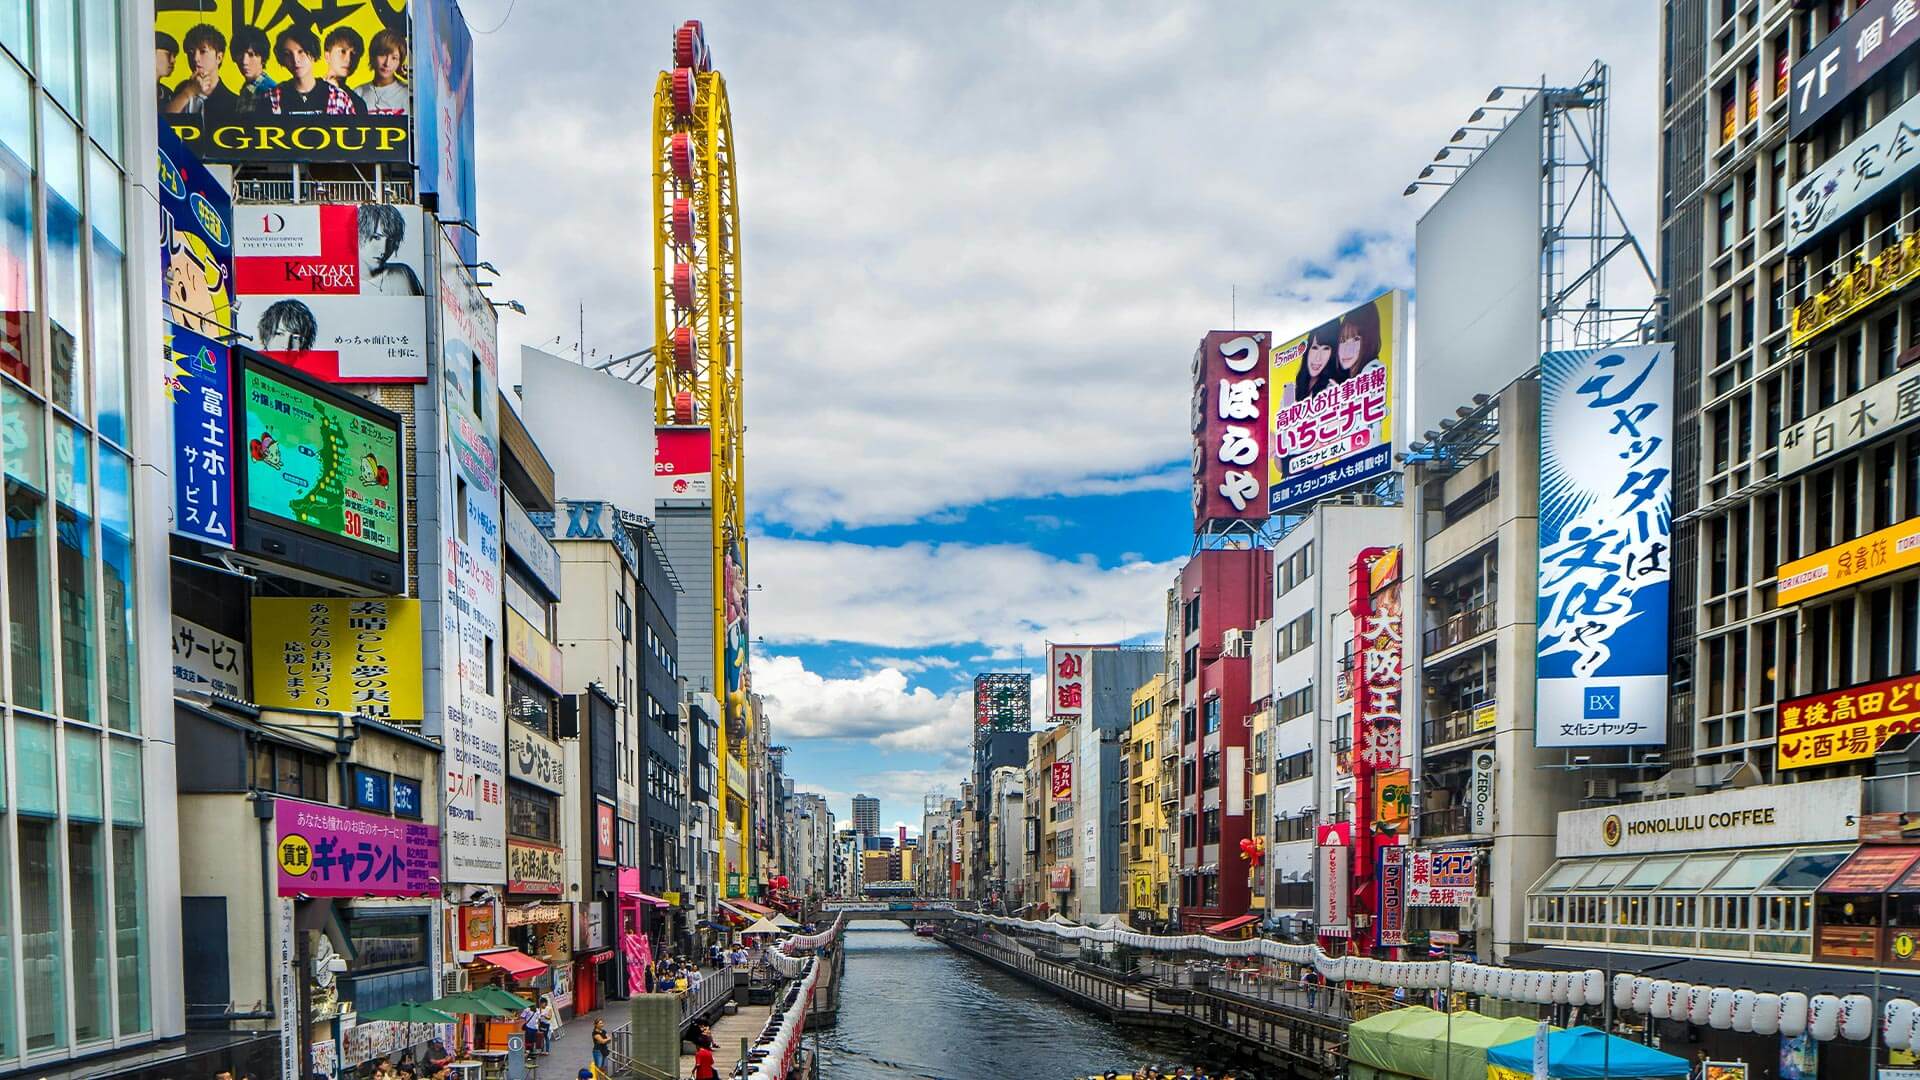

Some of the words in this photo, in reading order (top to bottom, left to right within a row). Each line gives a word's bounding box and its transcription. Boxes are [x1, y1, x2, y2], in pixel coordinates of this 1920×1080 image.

[1796, 46, 1841, 115] 7F
[212, 126, 407, 151] GROUP
[285, 262, 354, 281] KANZAKI
[311, 275, 355, 291] RUKA
[334, 335, 409, 346] めっちゃ面白いを
[387, 349, 420, 359] 仕事に。
[1276, 367, 1386, 429] 高収入お仕事情報
[1219, 333, 1265, 511] づぼらや
[1276, 397, 1386, 454] いちごナビ
[1783, 425, 1805, 450] 4F
[1812, 376, 1920, 461] 白木屋
[200, 386, 227, 538] 富士ホーム
[1292, 449, 1328, 470] いちごナビ
[1330, 443, 1347, 456] 求人
[184, 445, 201, 524] サービス
[345, 511, 361, 538] 30
[284, 641, 305, 699] 応援します
[310, 603, 332, 707] あなたのお店づくり
[350, 602, 389, 718] 素晴らしい夢の実現
[1361, 610, 1402, 768] 大阪王将
[1588, 695, 1615, 711] BX
[1803, 727, 1871, 760] 酒場
[364, 777, 374, 802] 酒
[393, 784, 412, 809] たばこ
[448, 772, 473, 798] コスパ
[1477, 772, 1489, 803] ZERO
[1628, 814, 1704, 836] HONOLULU
[1708, 807, 1776, 829] COFFEE
[283, 843, 309, 867] 賃貸
[313, 836, 405, 883] ギャラント
[1413, 853, 1430, 885] 薬
[1432, 855, 1473, 875] ダイコク
[1429, 888, 1456, 904] 免税
